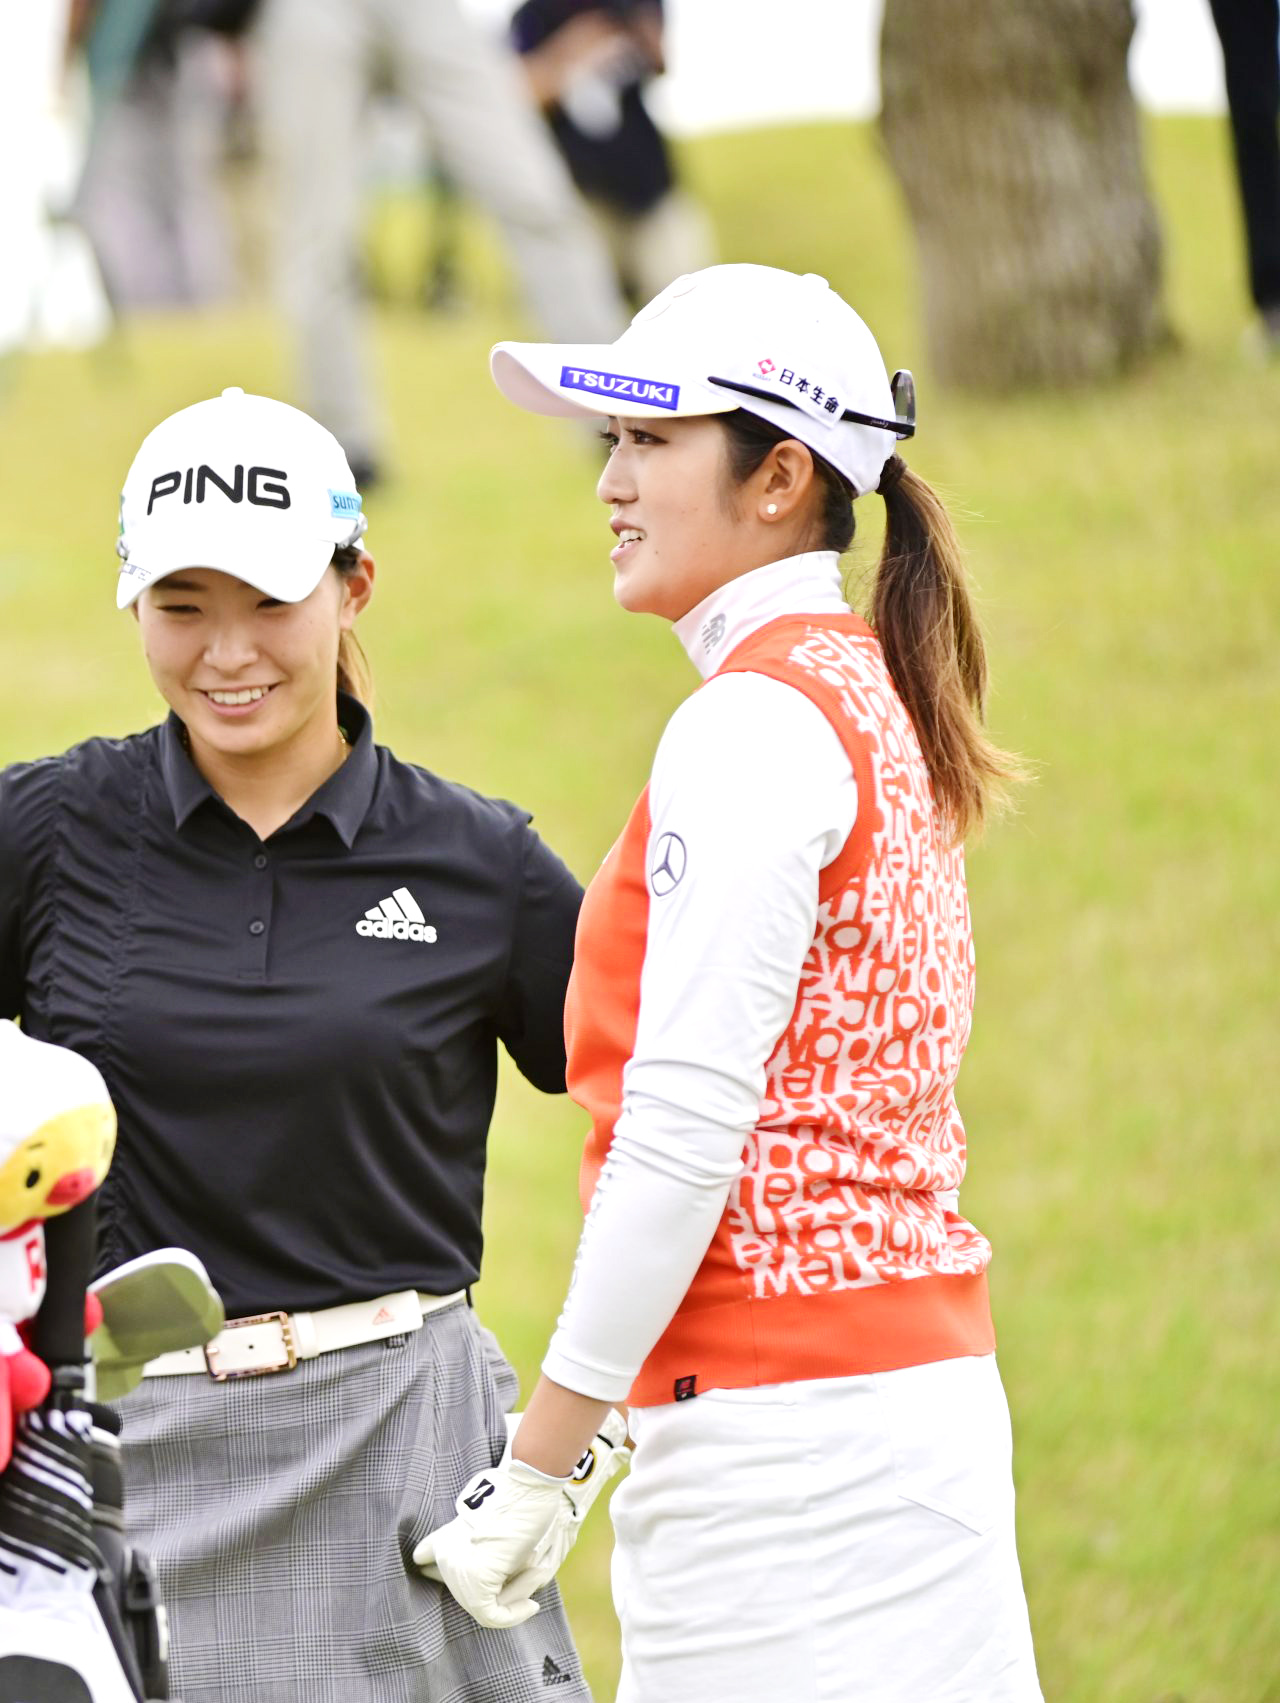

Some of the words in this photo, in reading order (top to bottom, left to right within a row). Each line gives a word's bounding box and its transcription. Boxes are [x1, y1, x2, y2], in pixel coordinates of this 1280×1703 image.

[567, 370, 674, 403] TSUZUKI
[779, 368, 840, 414] 日本生命
[147, 464, 291, 516] PING
[355, 917, 438, 944] adidas
